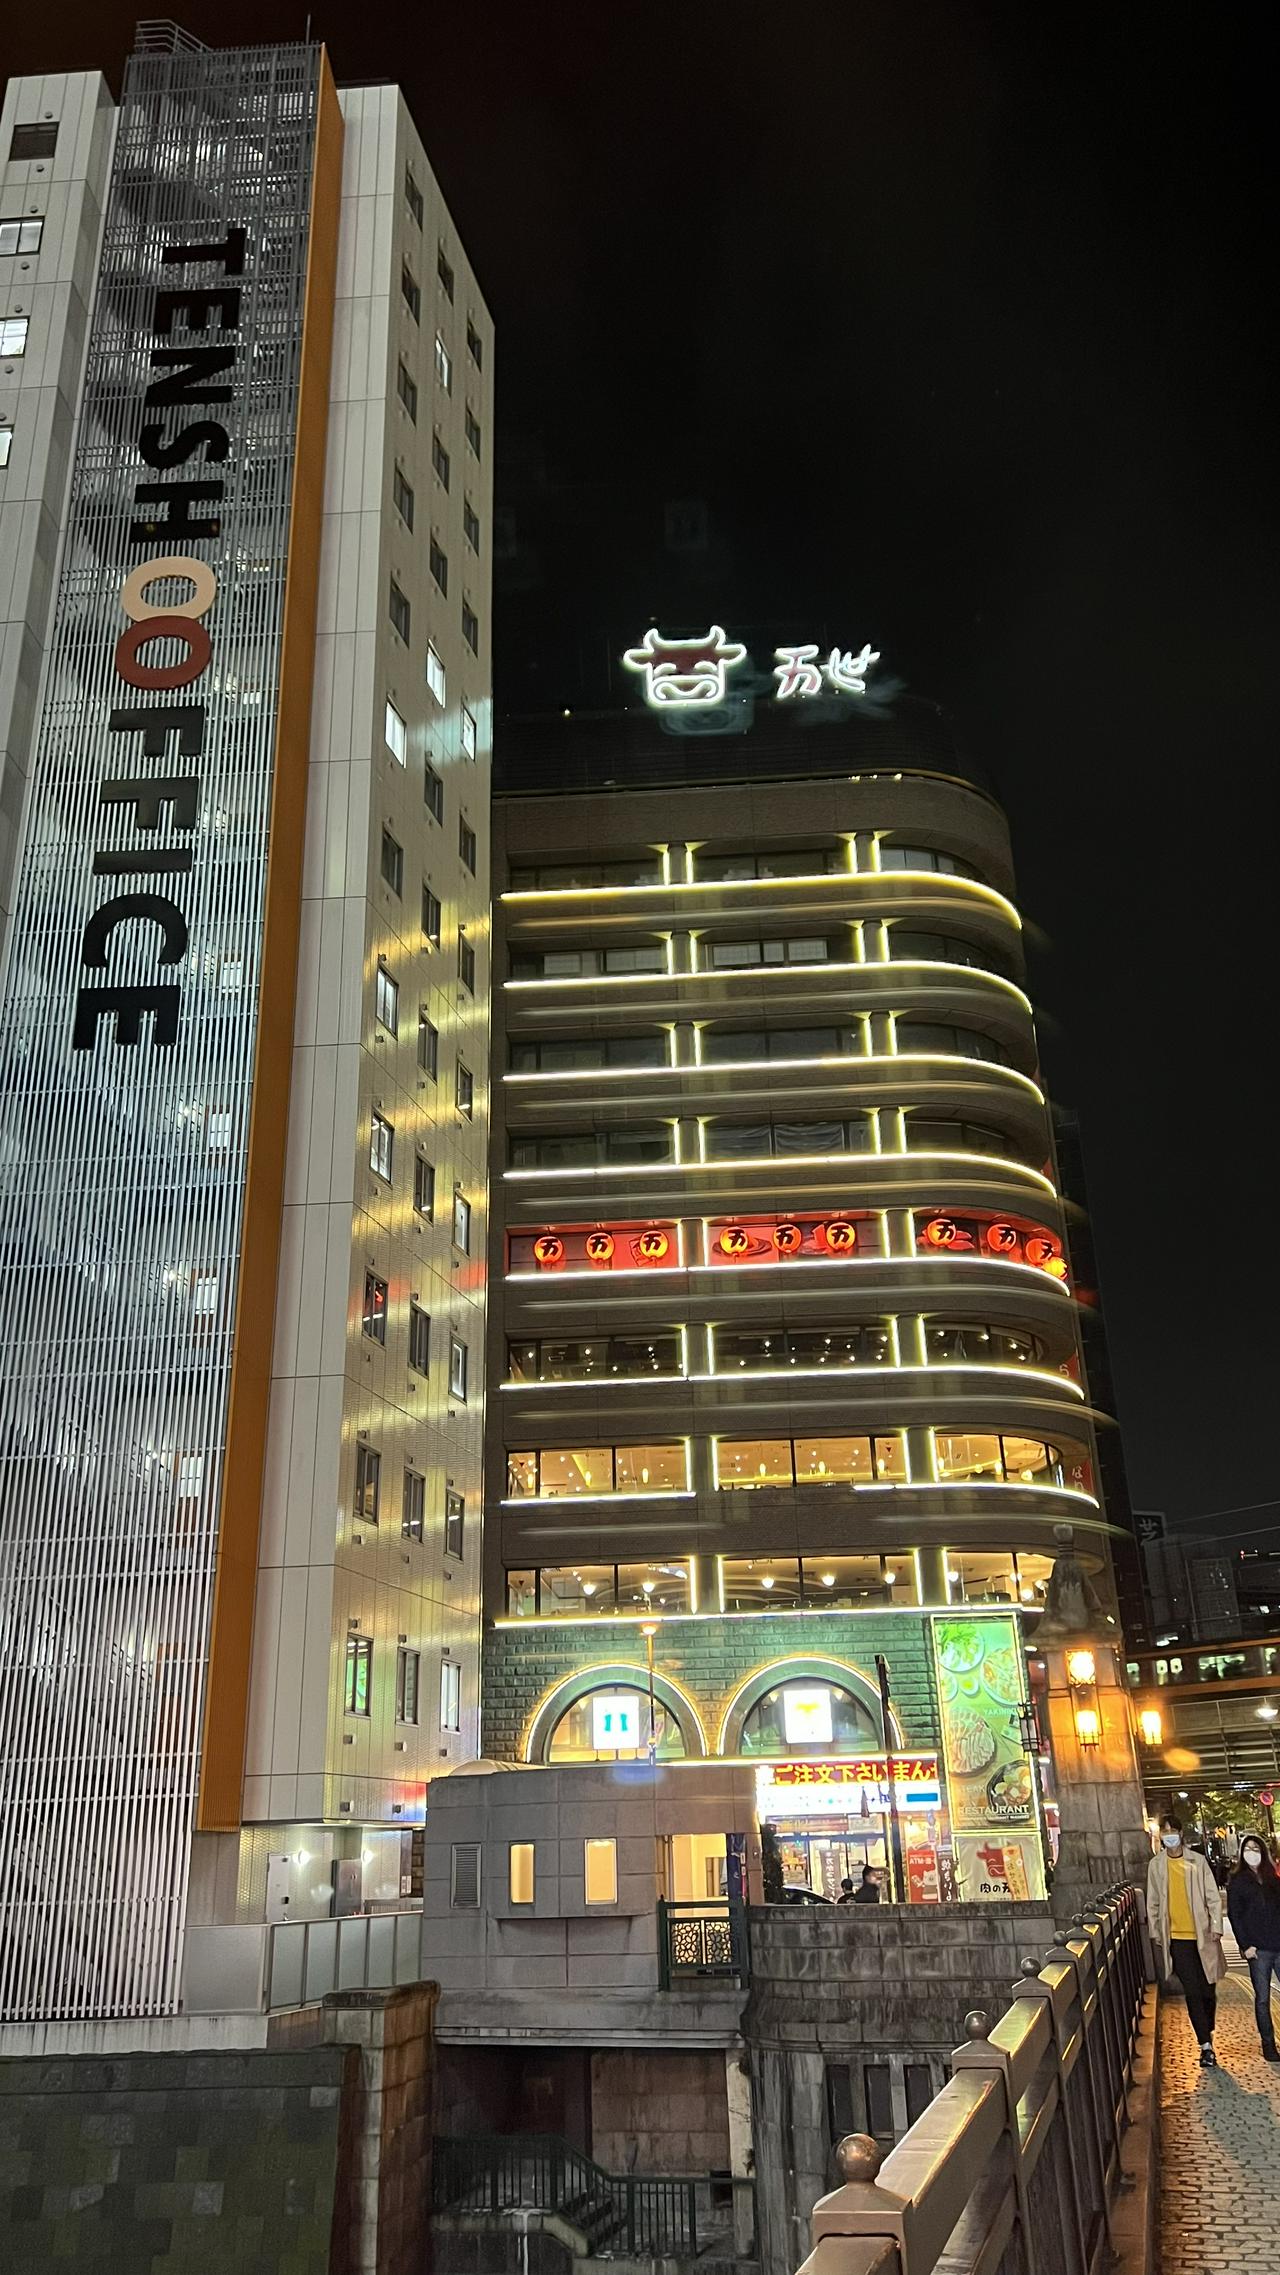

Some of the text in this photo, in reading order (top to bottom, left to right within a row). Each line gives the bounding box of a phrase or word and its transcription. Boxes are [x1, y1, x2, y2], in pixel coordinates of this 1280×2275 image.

[72, 227, 247, 1052] TENSHO OFFICE
[774, 643, 881, 699] 万世
[591, 1234, 609, 1254] 万
[643, 1233, 662, 1252] 万
[728, 1229, 746, 1248] 万
[776, 1226, 794, 1246] 万
[831, 1225, 850, 1245] 万
[540, 1238, 559, 1258] 万
[958, 1804, 1030, 1816] RESTAURANT
